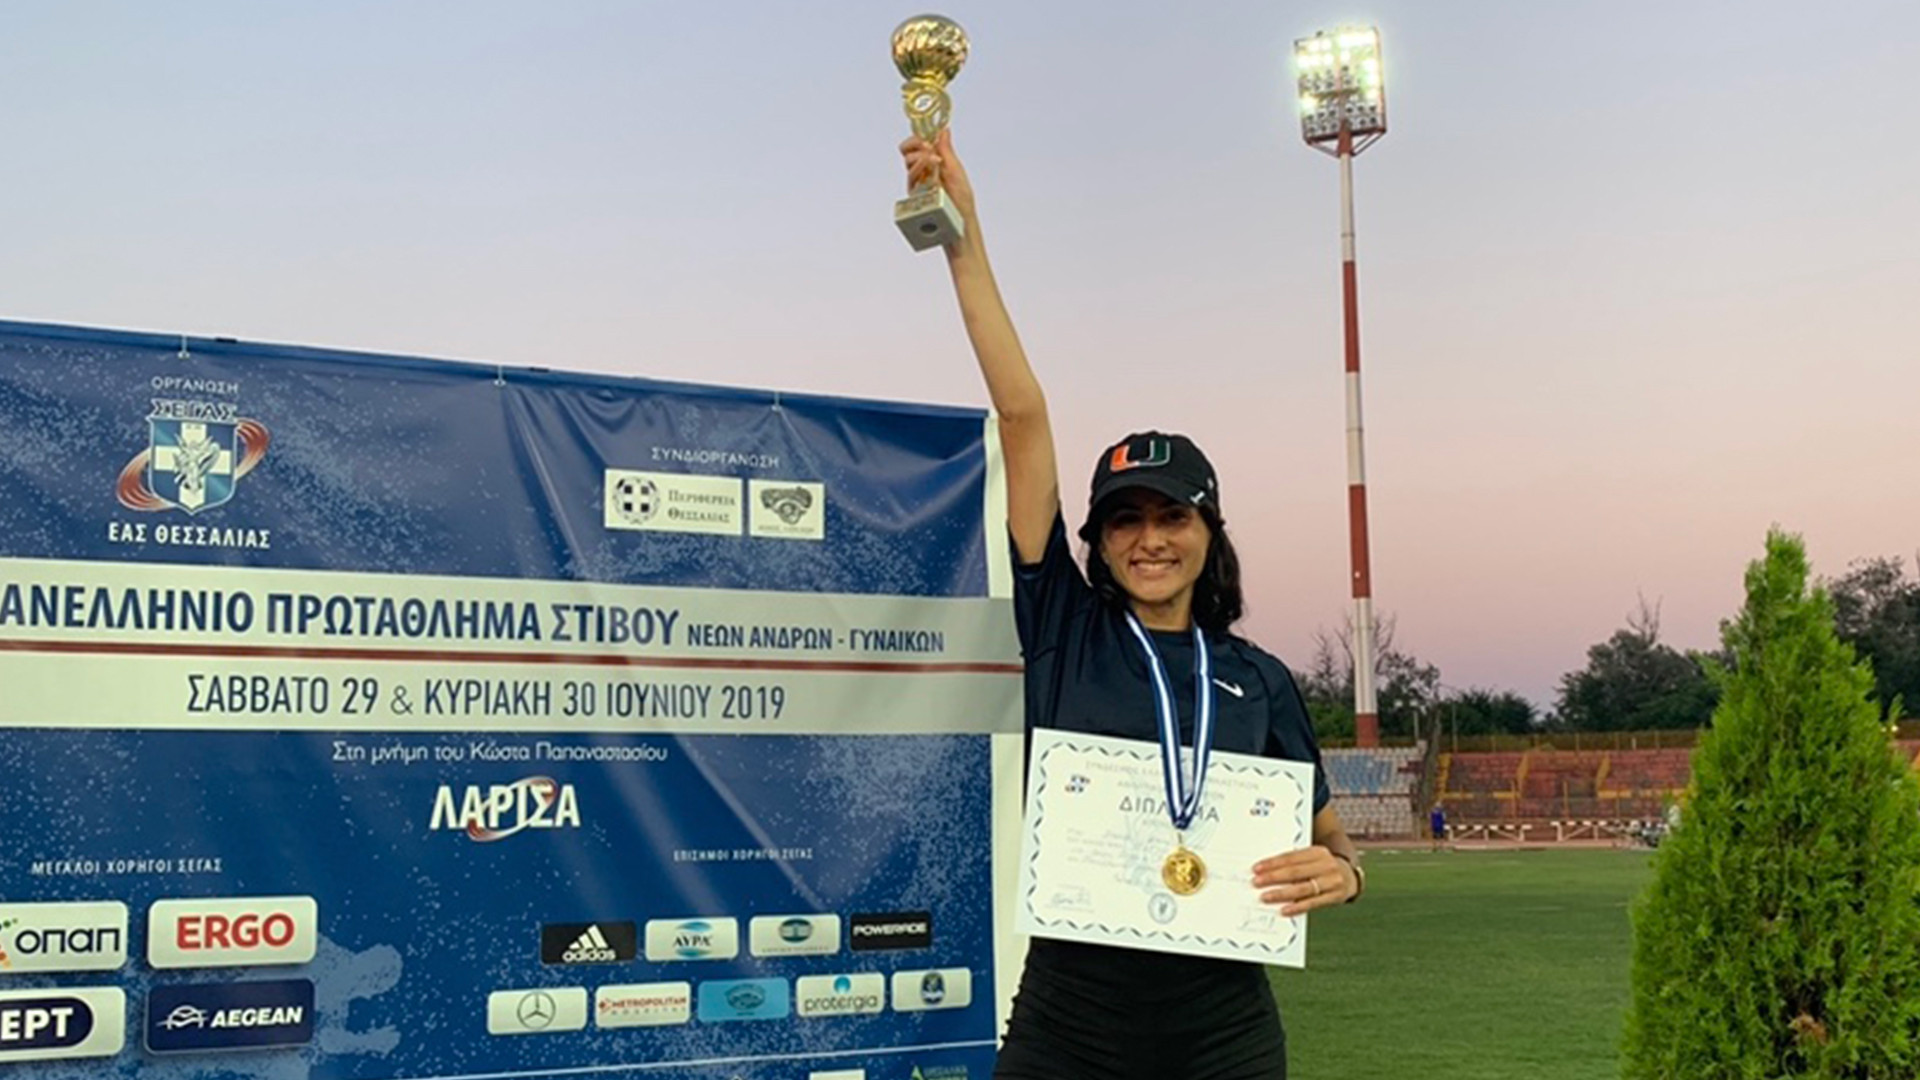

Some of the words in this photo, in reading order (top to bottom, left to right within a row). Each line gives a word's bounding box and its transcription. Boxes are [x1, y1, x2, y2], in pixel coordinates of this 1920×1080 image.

[151, 376, 239, 394] ΟΡΓΑΝΩΣΗ
[151, 399, 238, 421] ΣΕΓΑΣ
[651, 447, 780, 469] ΣΥΝΔΙΟΡΓΑΝΩΣΗ
[1110, 440, 1171, 473] U
[108, 522, 147, 543] ΕΑΣ
[155, 524, 271, 548] ΘΕΣΣΑΛΙΑΣ
[0, 584, 254, 633] ΑΝΕΛΛΗΝΙΟ
[267, 593, 541, 640] ΠΡΩΤΑΘΛΗΜΑ
[551, 603, 679, 645] ΣΤΙΒΟΥ
[688, 624, 743, 647] ΝΕΩΝ
[749, 626, 832, 650] ΑΝΔΡΩΝ
[850, 628, 944, 652] ΓΥΝΑΙΚΩΝ
[187, 675, 328, 713] ΣΑΒΒΑΤΟ
[342, 678, 378, 714] 29
[390, 685, 413, 714] &
[425, 679, 551, 717] ΚΥΡΙΑΚΗ
[563, 681, 596, 717] 30
[607, 682, 712, 718] ΙΟΥΝΙΟΥ
[721, 685, 785, 719] 2019
[332, 742, 365, 761] Στη
[371, 743, 428, 764] μνήμη
[434, 746, 465, 760] του
[471, 742, 530, 761] Κώστα
[535, 742, 668, 762] Παπαναστασίου
[430, 784, 581, 829] ΛΑΡΙΣΑ
[1119, 796, 1220, 822] ΔΙΠΛΑ
[31, 861, 100, 875] ΜΕΓΑΛΟΙ
[107, 860, 171, 874] ΧΟΡΗΓΟΙ
[178, 858, 222, 872] ΣΕΓΑΣ
[673, 849, 729, 862] ΕΠΙΣΗΜΟΙ
[733, 849, 779, 861] ΧΟΡΗΓΟΙ
[176, 913, 295, 950] ERGO
[853, 922, 927, 936] POWERADE
[562, 949, 616, 963] adidas
[804, 994, 878, 1012] protergia
[0, 1007, 74, 1041] ΕΡΤ
[210, 1006, 303, 1028] AEGEAN
